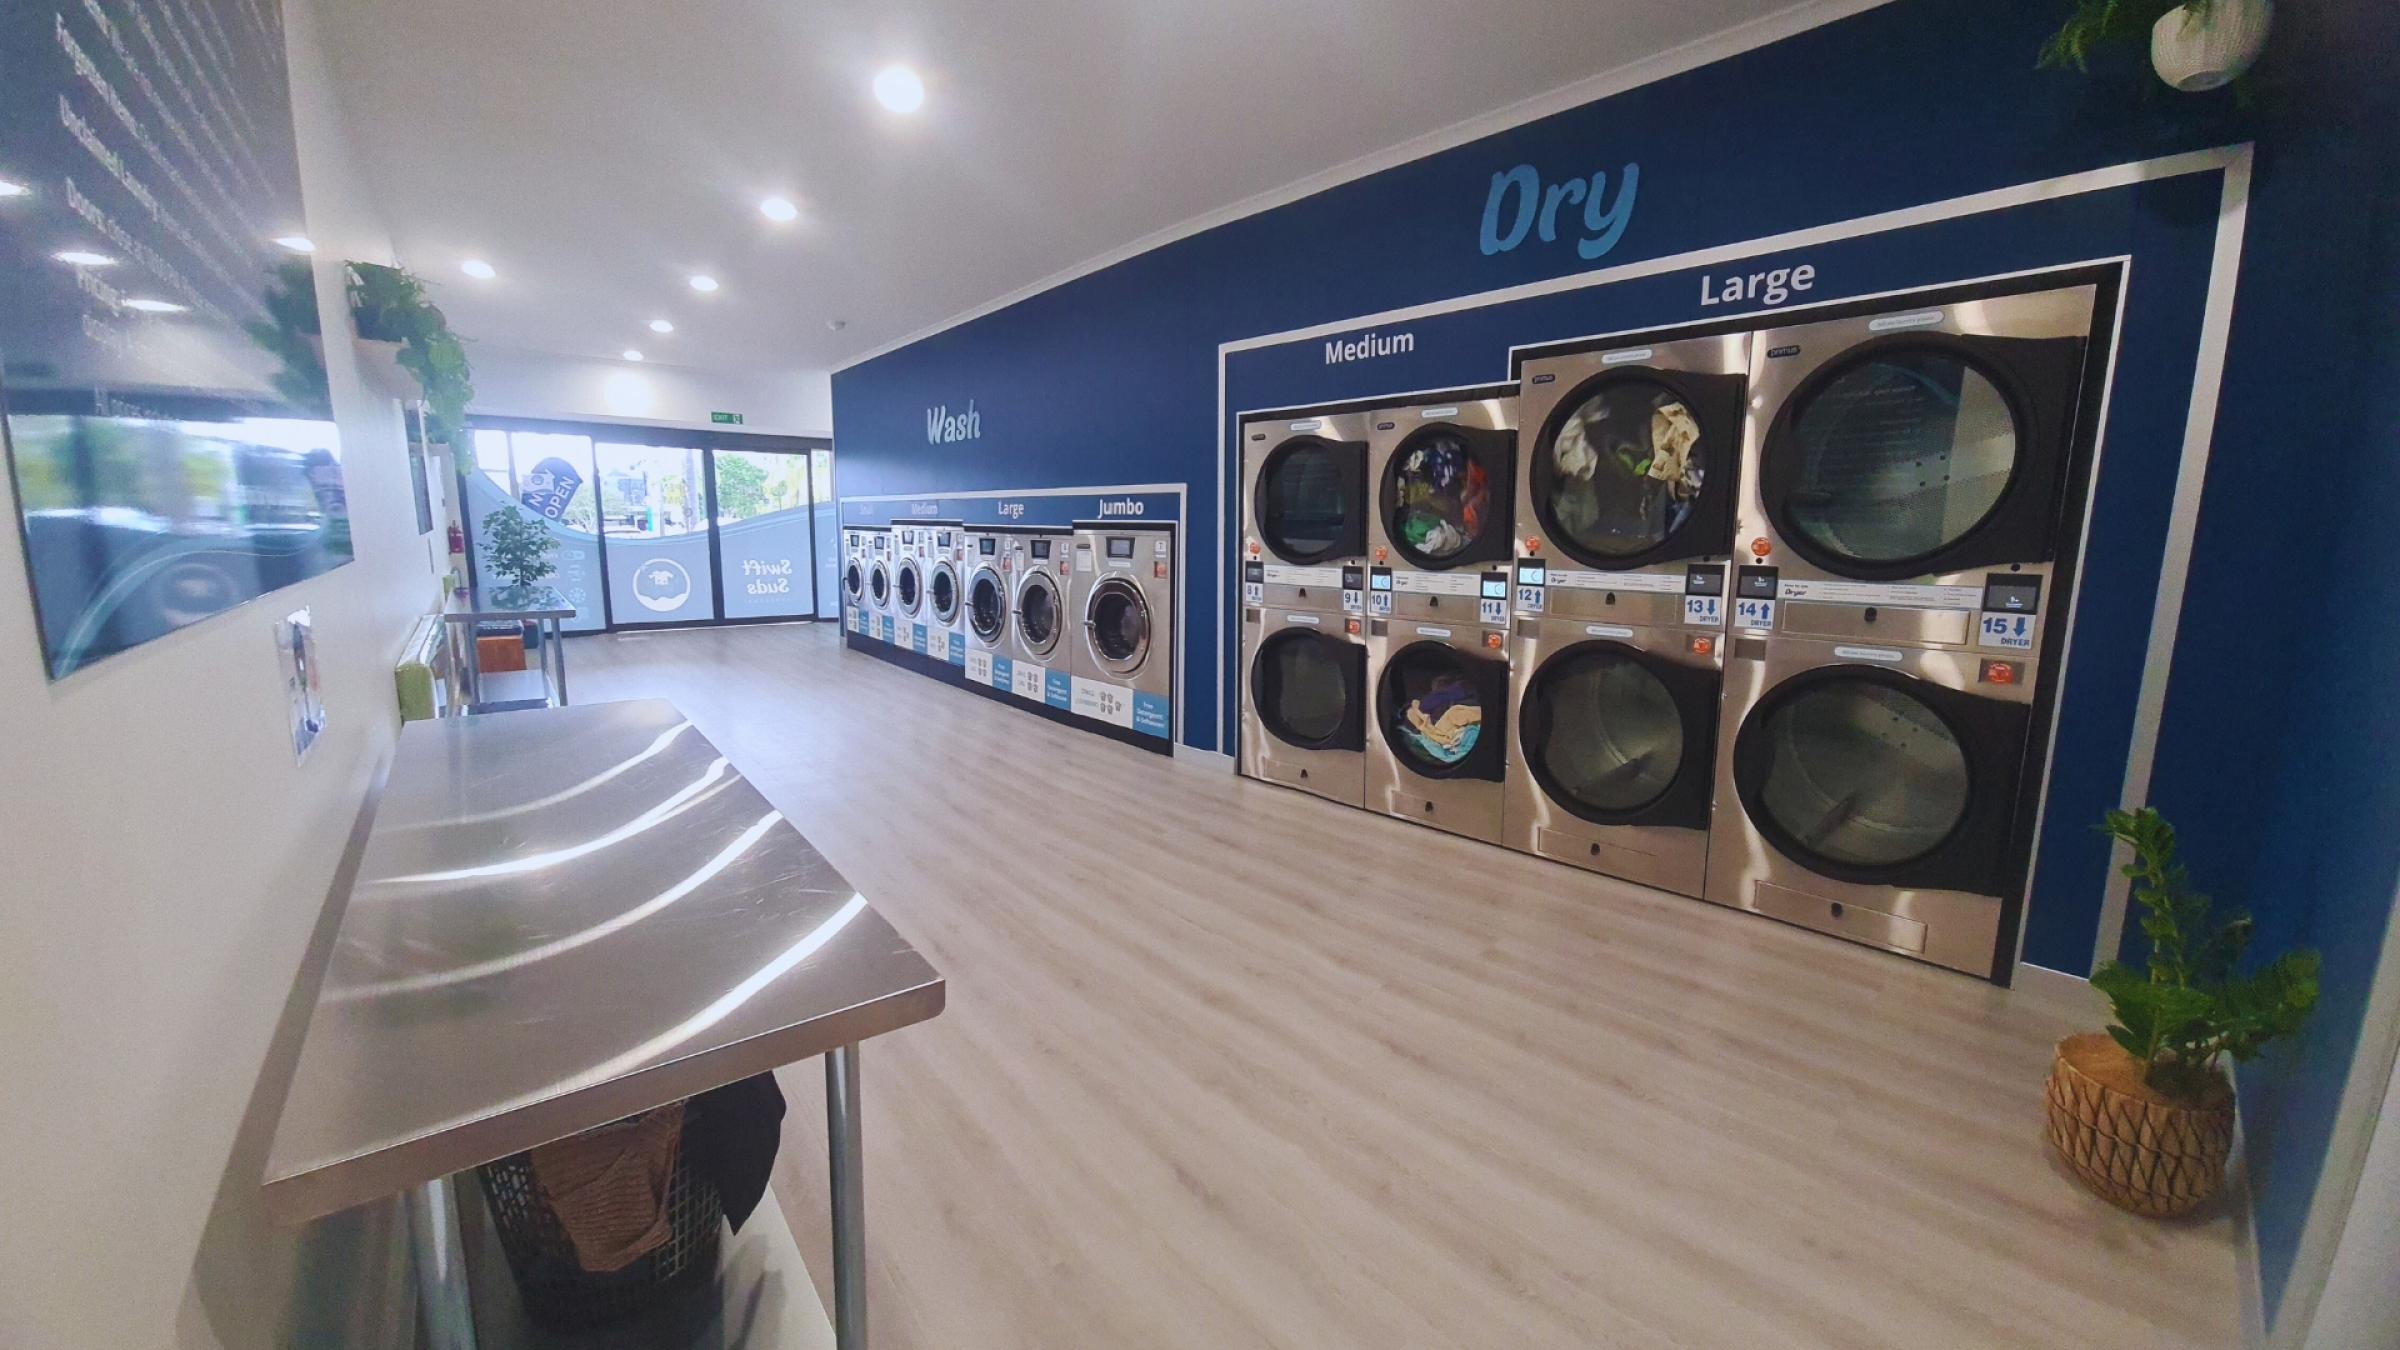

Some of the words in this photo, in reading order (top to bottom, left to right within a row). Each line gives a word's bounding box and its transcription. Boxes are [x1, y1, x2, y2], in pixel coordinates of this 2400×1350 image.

[1479, 162, 1640, 260] Dry
[1700, 263, 1816, 306] Large
[1325, 332, 1415, 365] Medium
[926, 399, 981, 445] Wash
[544, 475, 575, 518] OPEN
[998, 500, 1025, 519] Large
[1098, 498, 1145, 519] Jumbo
[1344, 592, 1351, 603] 9
[1371, 594, 1381, 605] 10
[1518, 589, 1532, 601] 12
[1482, 602, 1492, 614] 11
[1686, 599, 1703, 613] 13
[1738, 602, 1757, 617] 14
[1983, 617, 2008, 634] 15
[2000, 637, 2030, 647] DRYER
